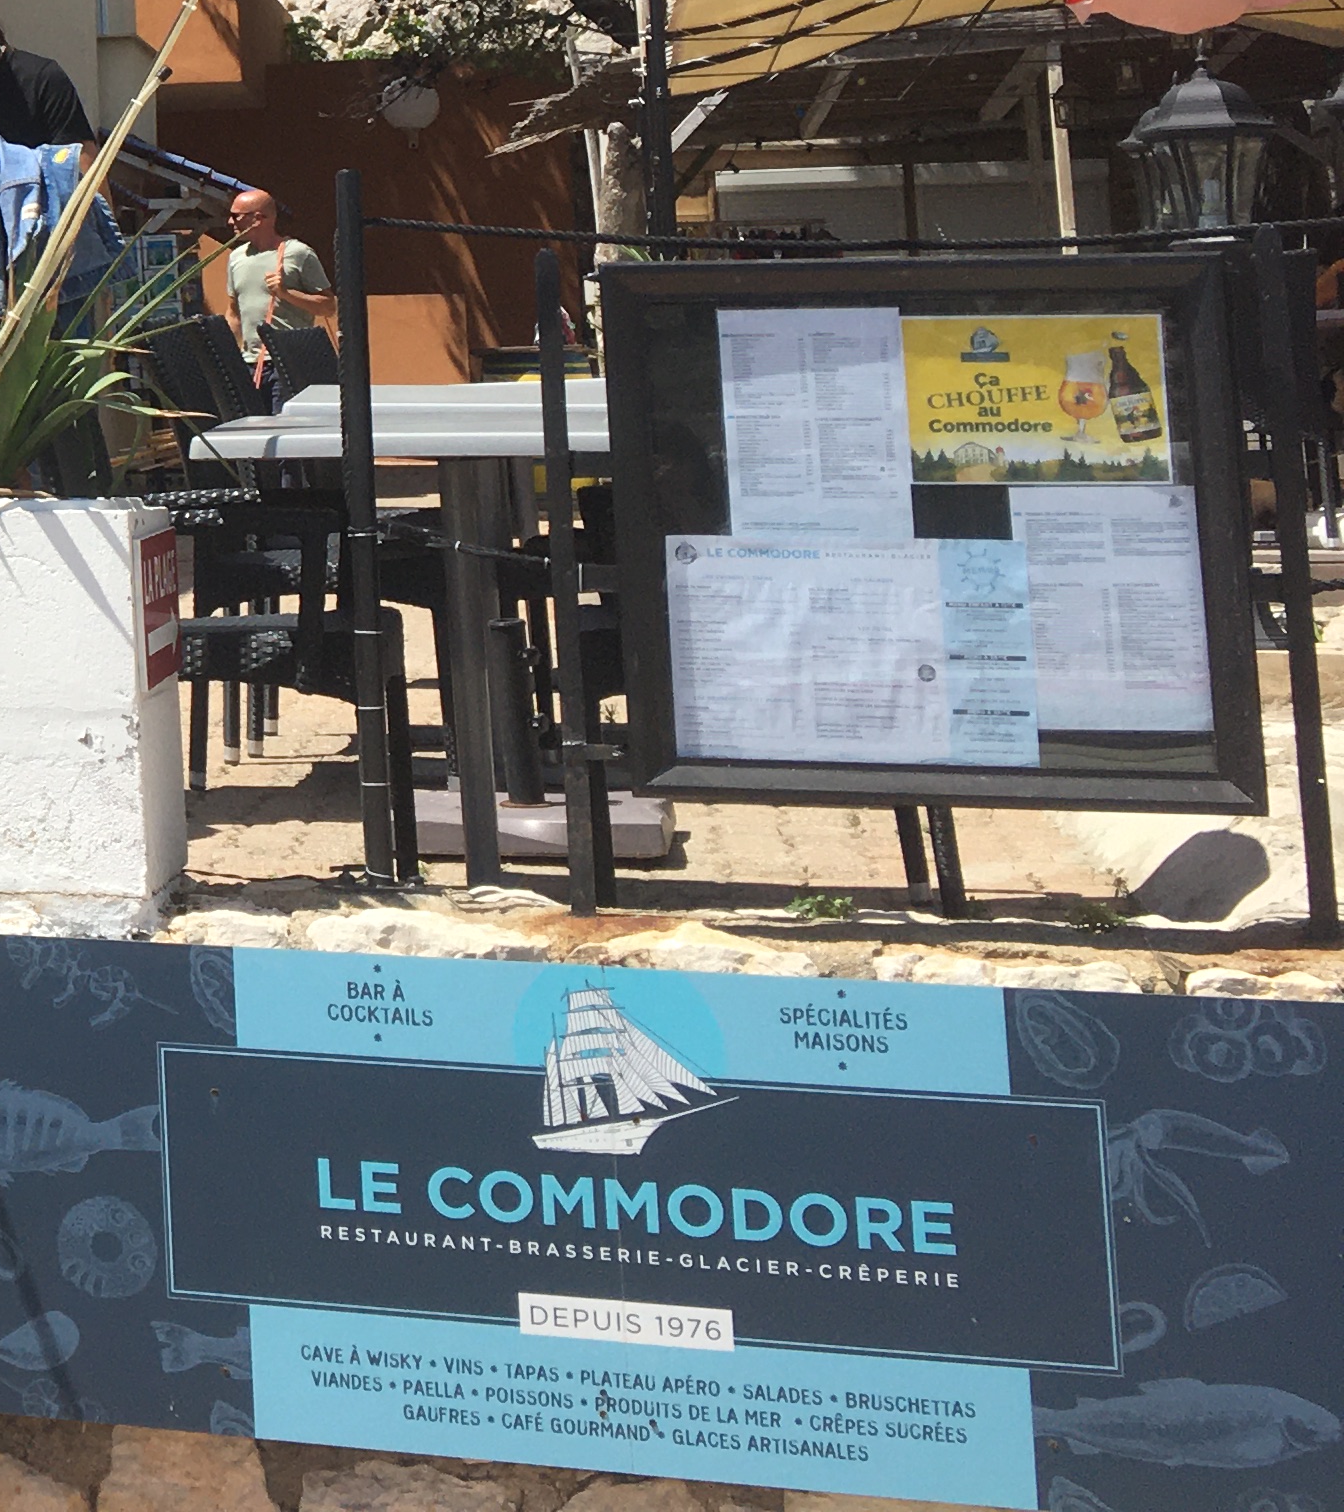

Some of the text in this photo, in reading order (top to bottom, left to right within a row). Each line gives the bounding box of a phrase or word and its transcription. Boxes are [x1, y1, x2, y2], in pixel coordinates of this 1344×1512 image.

[974, 372, 1000, 390] Ça
[927, 384, 1051, 410] CHOUFFE
[977, 405, 1001, 418] au
[928, 419, 1053, 433] Commodore
[706, 548, 821, 560] LE COMMODORE
[347, 979, 405, 1002] BAR À
[327, 1004, 434, 1027] COCKTAILS
[780, 1003, 908, 1030] SPÉCIALITÉS
[794, 1031, 889, 1054] MAISONS
[317, 1157, 958, 1256] LE COMMODORE
[320, 1225, 960, 1288] RESTAURANT-BRASSERIE-GLACIER-CRÊPERIE
[530, 1305, 722, 1341] DEPUIS 1976
[301, 1344, 977, 1418] CAVE À WISKY VINS TAPAS PLATEAU APÉRO SALADES BRUSCHETTAS
[311, 1370, 969, 1444] VIANDES PAELLA POISSONS PRODUITS DE LA MER CRÊPES SUCRÉES
[403, 1404, 869, 1462] GAUFRES CAFÉ GOURMAND GLACES ARTISANALES
